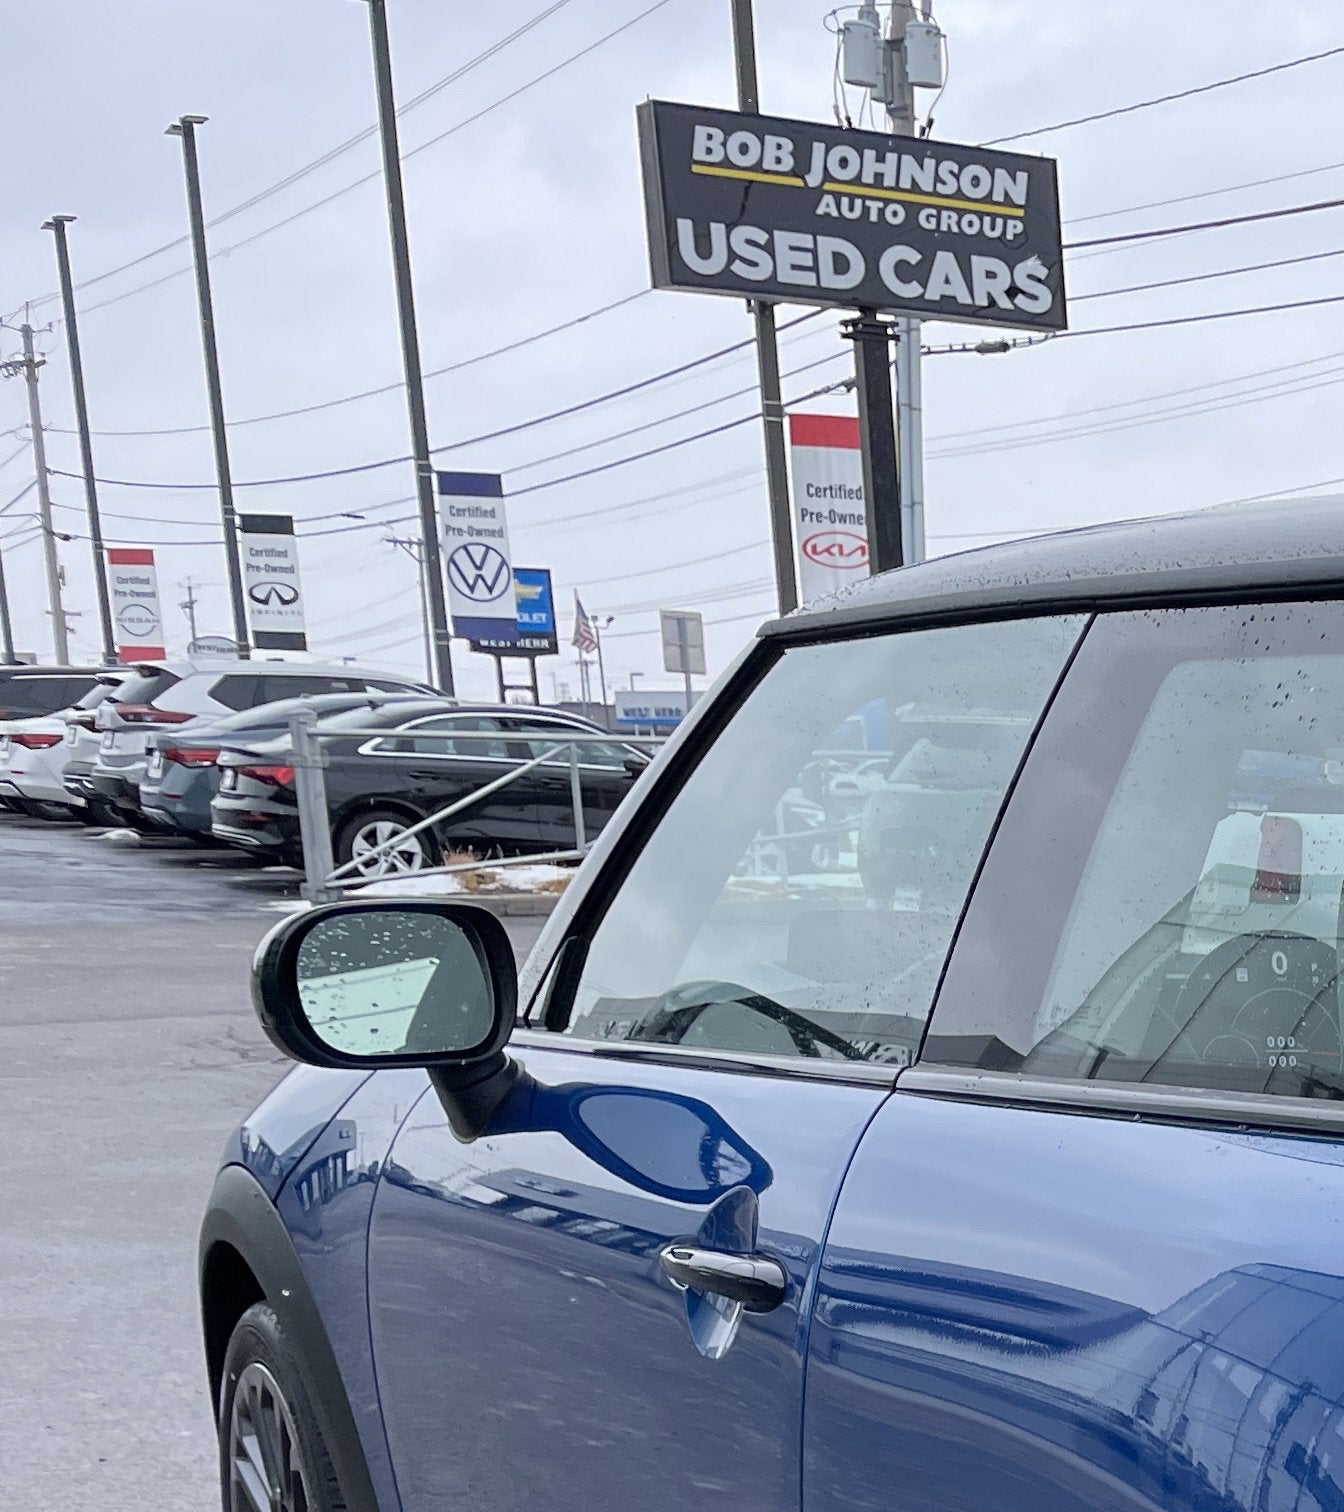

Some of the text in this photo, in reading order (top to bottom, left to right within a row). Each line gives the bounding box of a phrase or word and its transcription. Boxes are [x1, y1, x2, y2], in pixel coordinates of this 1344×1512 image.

[691, 125, 1028, 206] BOB JOHNSON
[815, 194, 1025, 241] AUTO GROUP
[677, 217, 1054, 314] USED CARS
[806, 483, 863, 500] Certified
[449, 505, 496, 519] Certified
[801, 508, 864, 526] Pre-Owne
[445, 525, 504, 538] Pre-Owned
[249, 548, 288, 558] Certified
[246, 563, 295, 574] Pre-Owned
[116, 576, 150, 585] Certified
[114, 589, 156, 598] Pre-Owned
